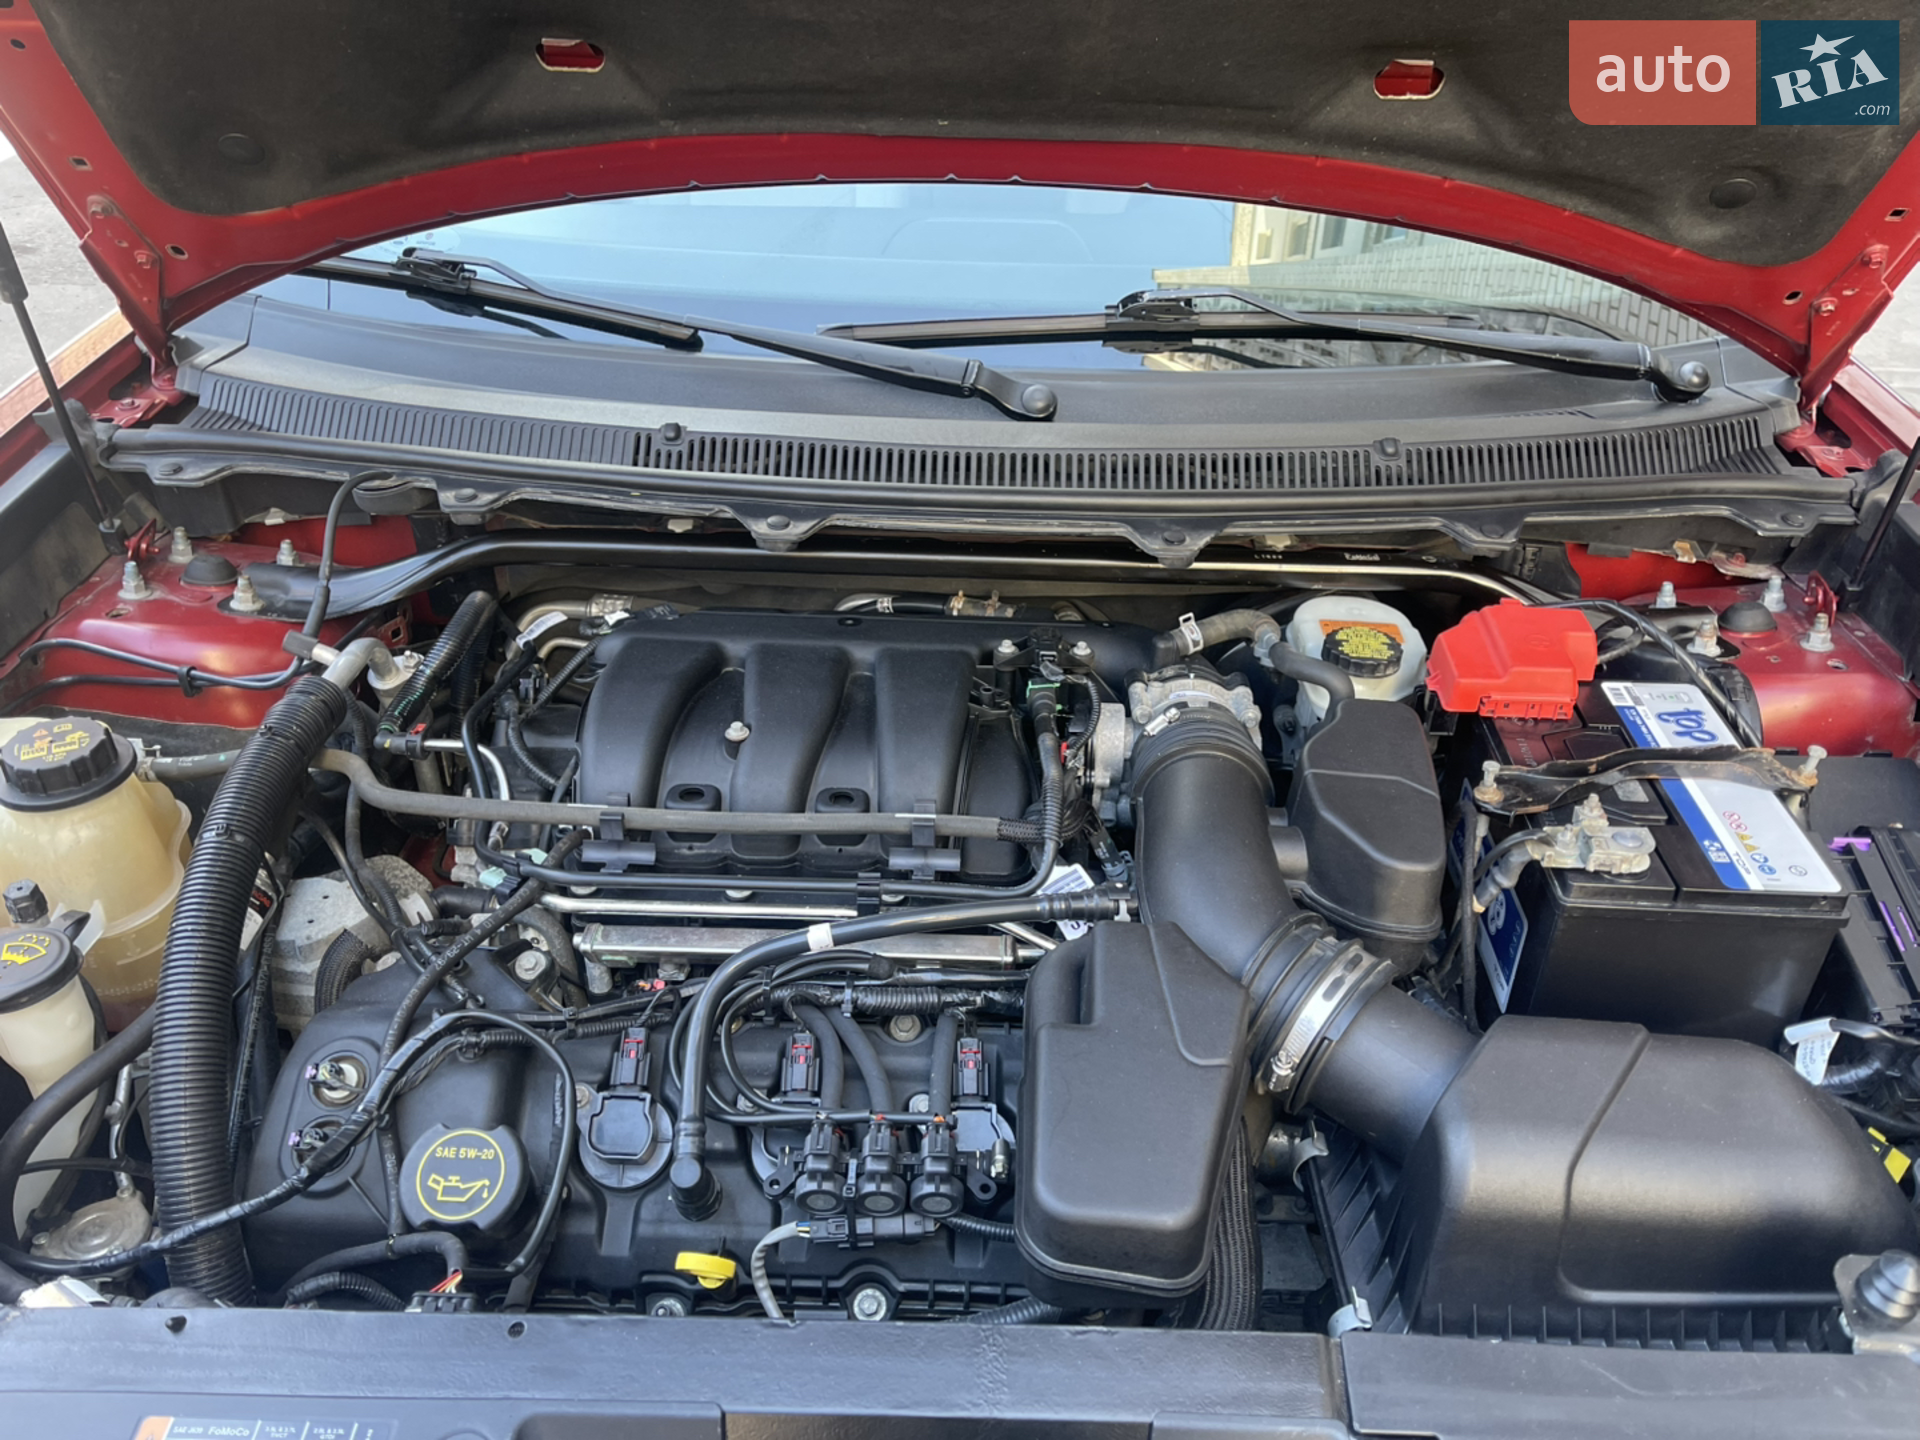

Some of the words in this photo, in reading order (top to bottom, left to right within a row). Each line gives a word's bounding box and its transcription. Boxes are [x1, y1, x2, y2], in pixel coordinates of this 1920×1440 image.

[435, 1146, 458, 1158] SAE
[458, 1147, 495, 1160] 5W-20
[207, 1425, 250, 1437] FoMoCo
